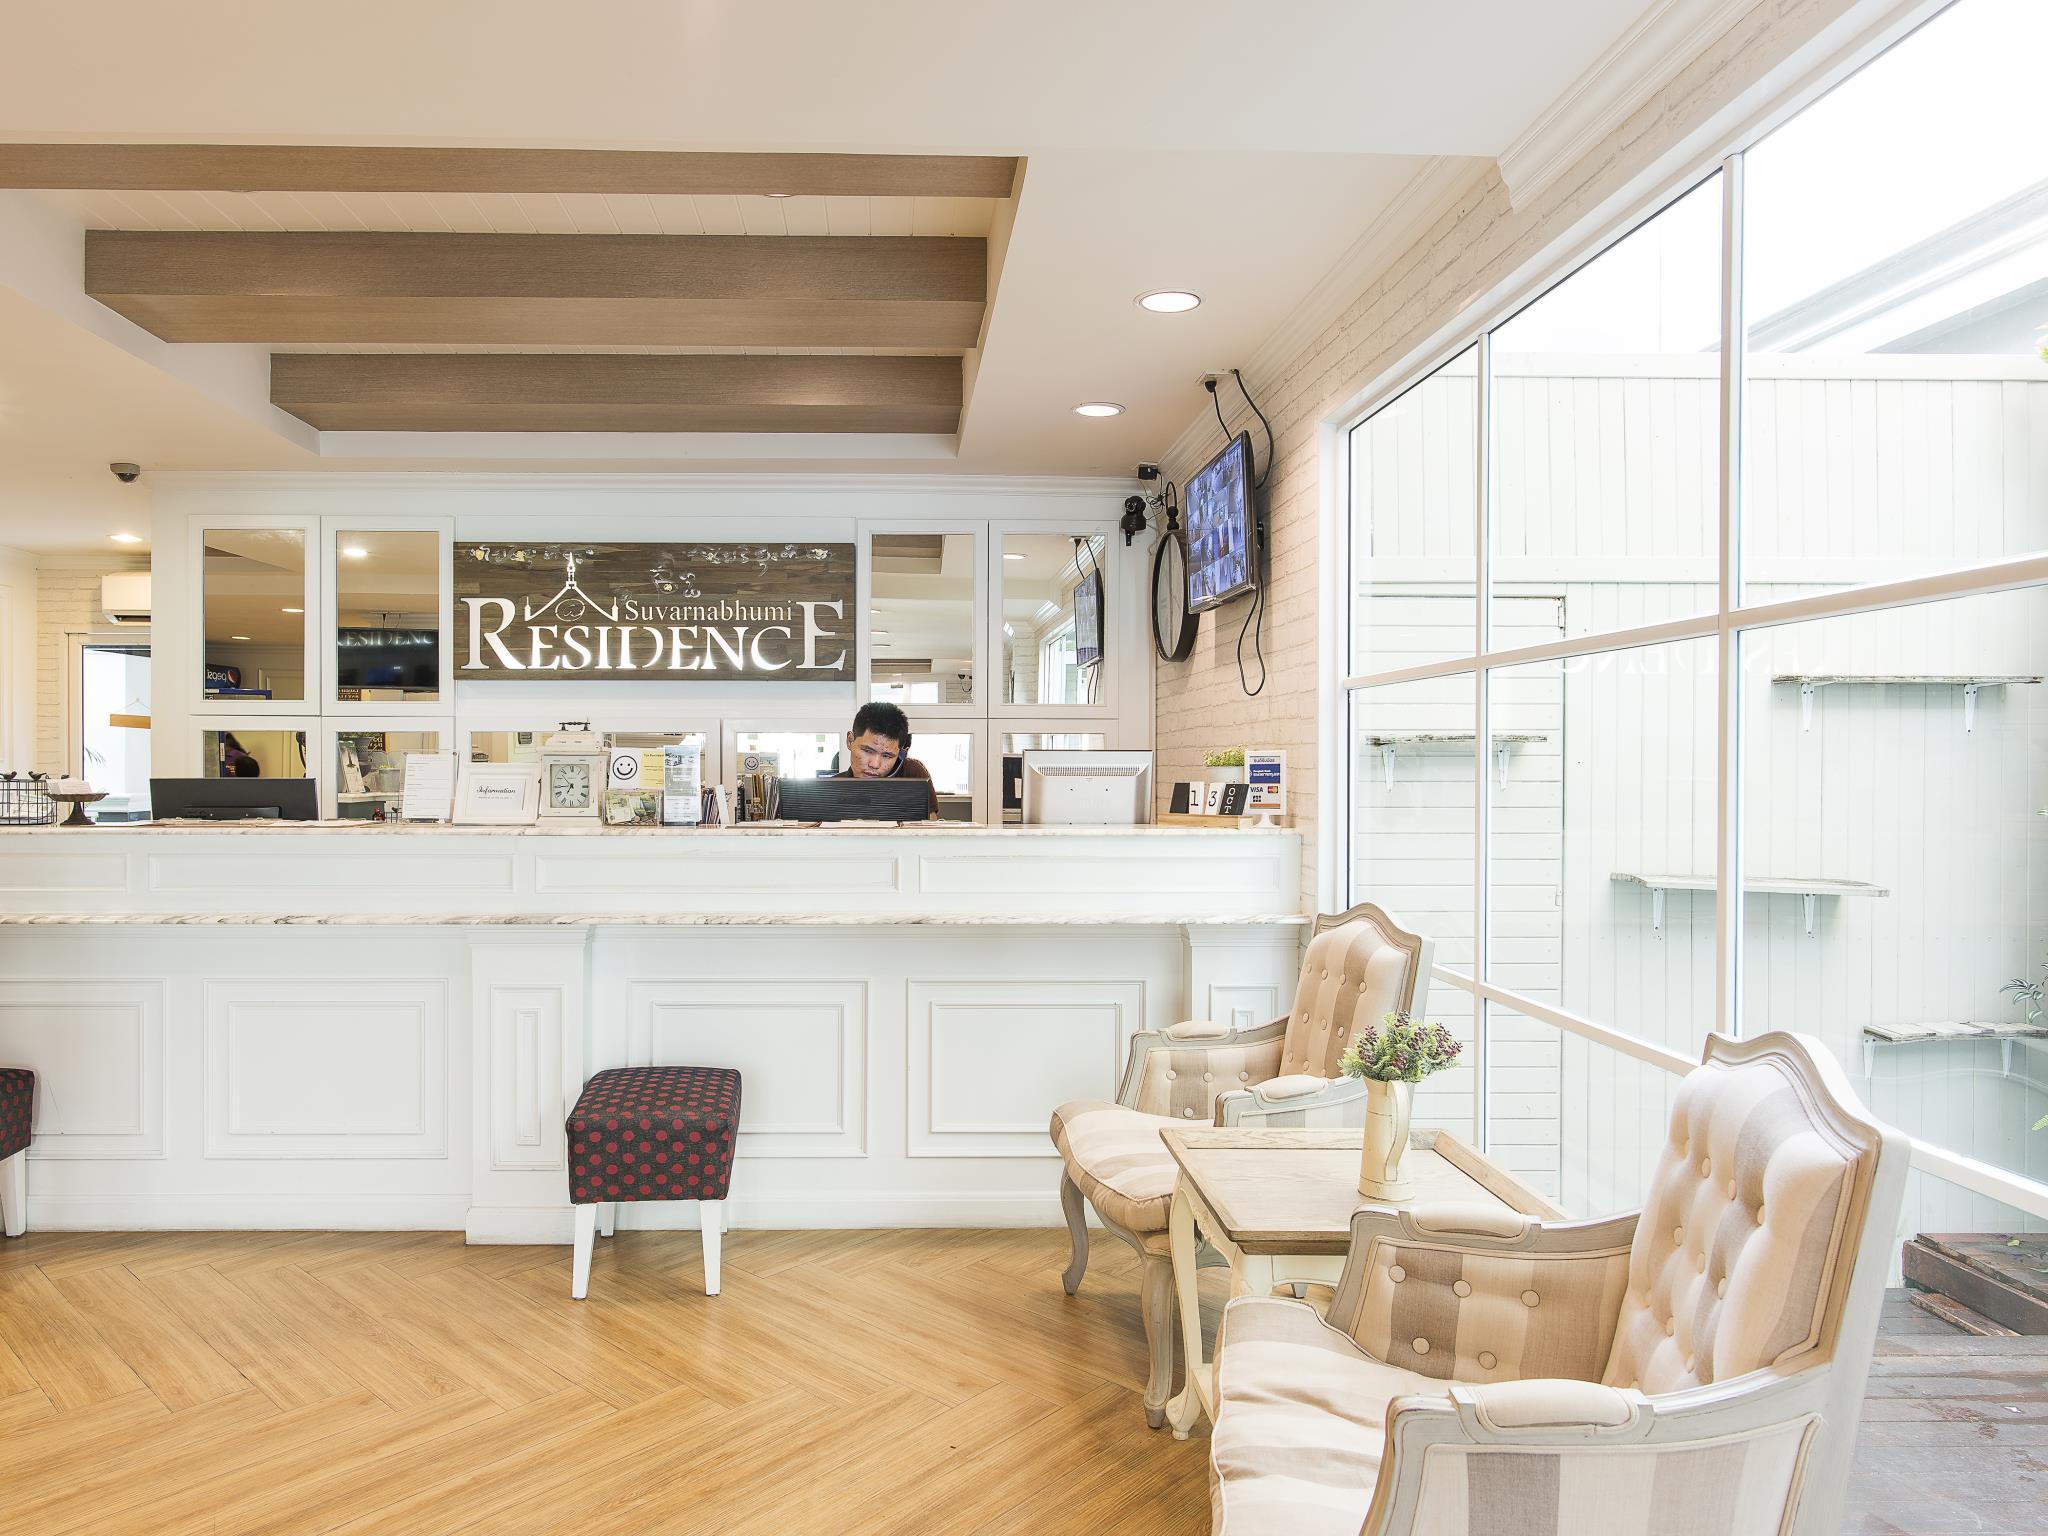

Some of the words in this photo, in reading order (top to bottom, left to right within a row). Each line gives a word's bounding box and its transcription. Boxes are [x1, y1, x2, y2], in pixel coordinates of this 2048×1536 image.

[625, 599, 793, 622] Suvarnabhumi
[460, 597, 847, 672] RESIDENCE
[476, 785, 516, 795] Information
[1209, 791, 1218, 807] 3
[1224, 788, 1236, 814] OCT
